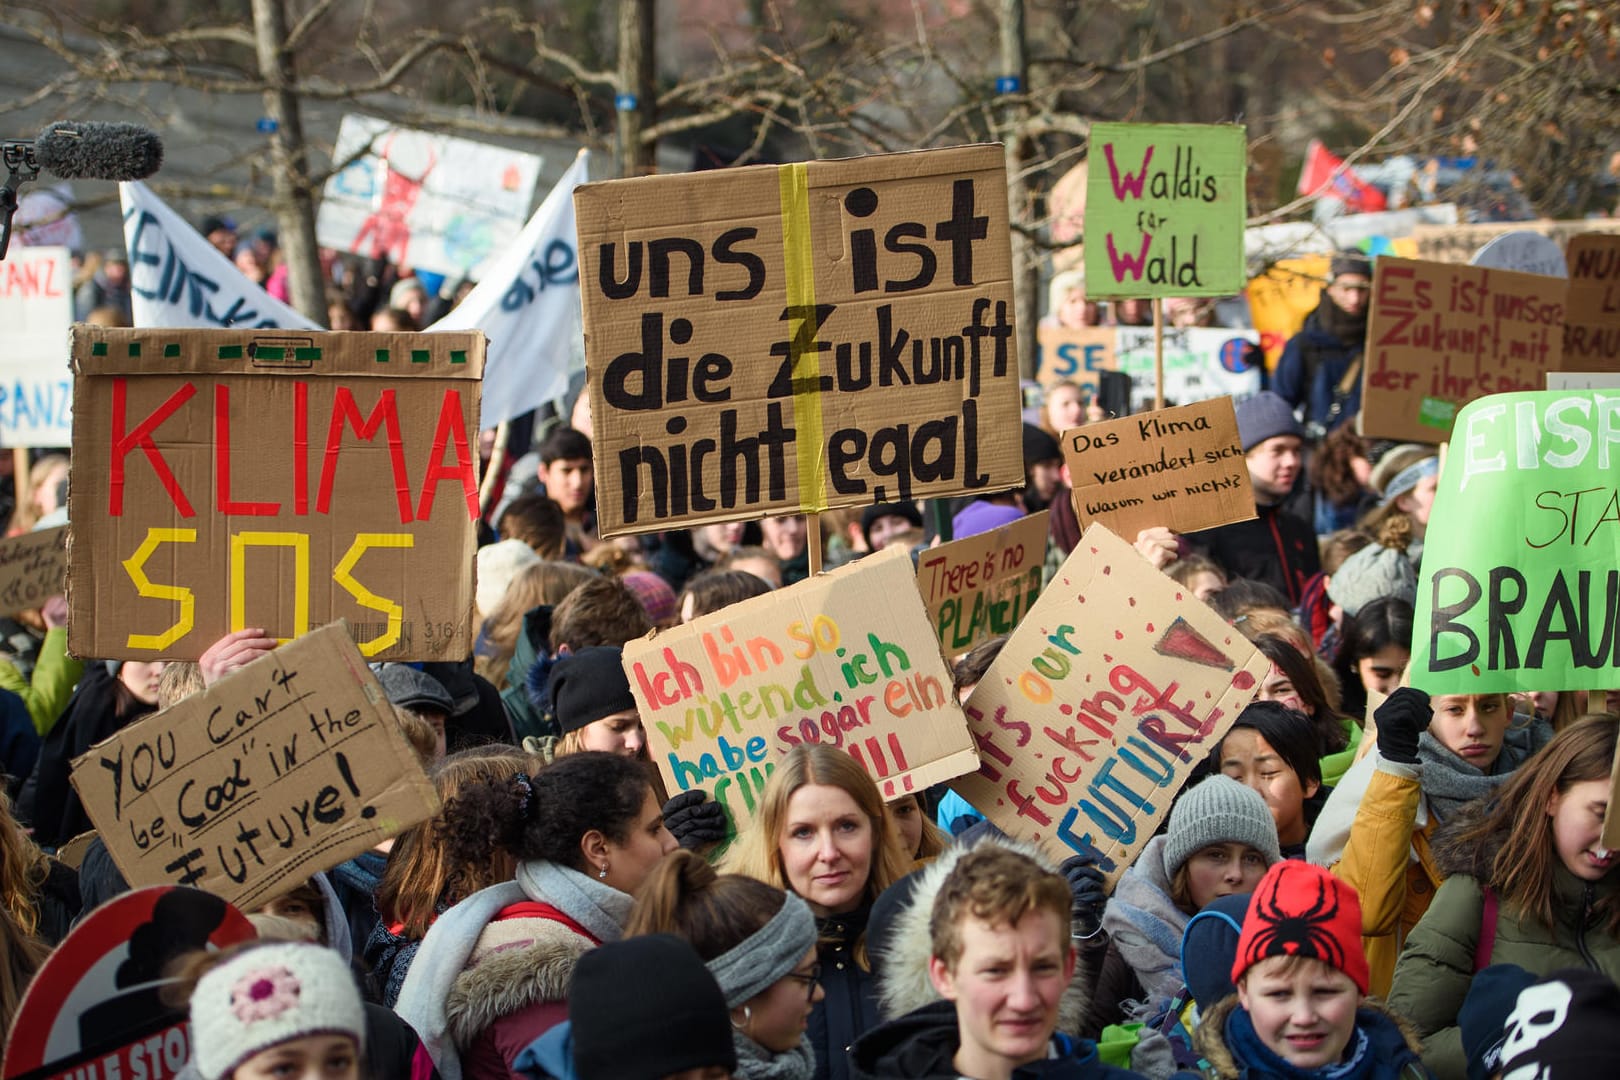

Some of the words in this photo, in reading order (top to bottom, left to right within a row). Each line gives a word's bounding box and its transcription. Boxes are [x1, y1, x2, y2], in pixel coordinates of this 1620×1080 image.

[1104, 143, 1217, 202] Waldis
[0, 258, 63, 299] ANZ
[600, 227, 766, 300] uns
[844, 179, 989, 294] ist
[1106, 232, 1203, 287] Wald
[1378, 266, 1433, 310] Es
[1449, 270, 1490, 317] ist
[602, 312, 733, 411] die
[767, 297, 1013, 399] Zukunft
[108, 378, 481, 524] KLIMA
[619, 401, 796, 523] nicht
[827, 399, 991, 504] egal
[1072, 431, 1120, 453] Das
[1138, 415, 1211, 442] Klima
[1094, 446, 1195, 486] verändert
[1204, 445, 1244, 464] sich
[1152, 489, 1178, 502] wir
[1185, 474, 1241, 496] nicht?
[122, 527, 414, 657] SOS
[924, 556, 980, 603] There
[982, 551, 997, 580] is
[1001, 543, 1025, 572] no
[1428, 565, 1620, 672] BRAU
[633, 646, 704, 711] Ich
[702, 624, 785, 689] bin
[786, 614, 842, 660] so
[835, 632, 912, 690] ich
[1018, 624, 1083, 705] our
[130, 816, 164, 849] be
[309, 708, 361, 744] the
[667, 735, 769, 791] habe
[776, 694, 877, 754] sogar
[1056, 681, 1225, 873] FUTURE
[129, 1022, 192, 1080] STO
